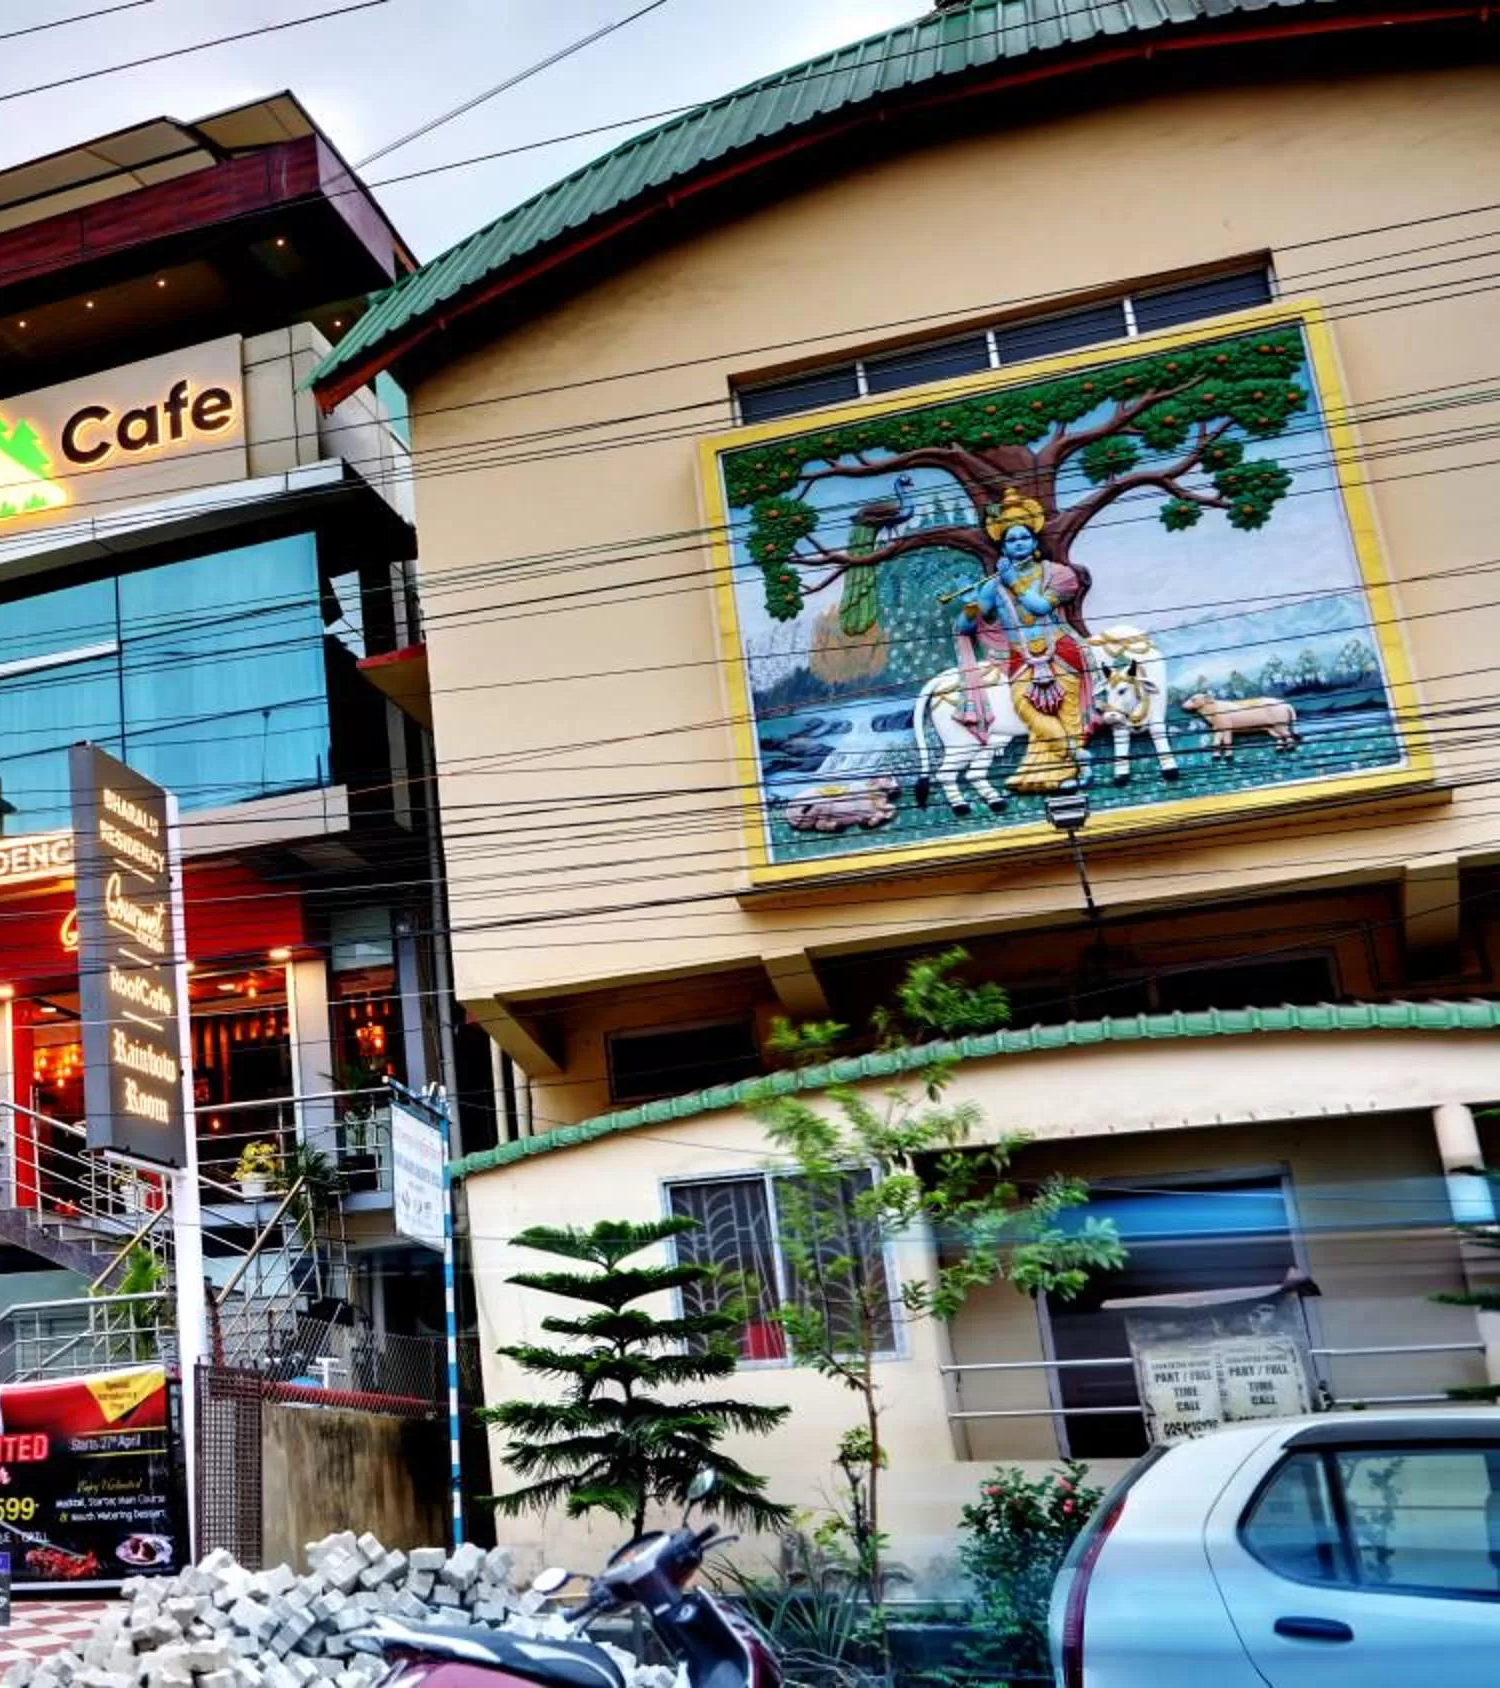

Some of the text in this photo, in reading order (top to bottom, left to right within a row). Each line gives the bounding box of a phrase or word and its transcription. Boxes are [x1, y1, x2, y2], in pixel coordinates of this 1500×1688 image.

[60, 378, 234, 464] Cafe
[113, 1027, 177, 1084] Rainbow
[124, 1077, 170, 1125] Room
